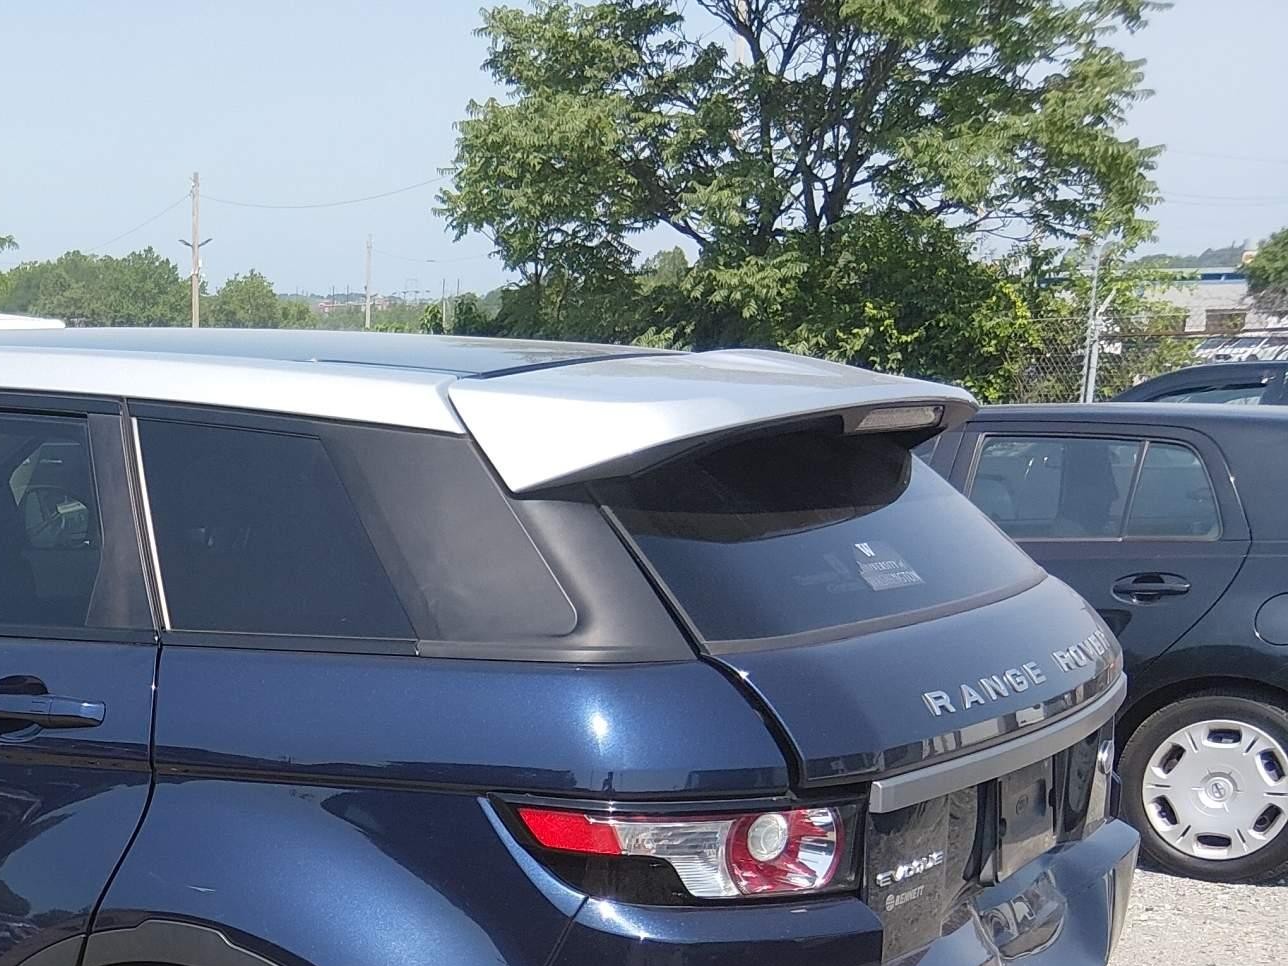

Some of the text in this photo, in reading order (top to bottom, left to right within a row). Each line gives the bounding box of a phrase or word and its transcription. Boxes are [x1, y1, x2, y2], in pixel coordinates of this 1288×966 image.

[921, 628, 1112, 717] RANGE ROVER
[894, 884, 925, 906] BENNETT
